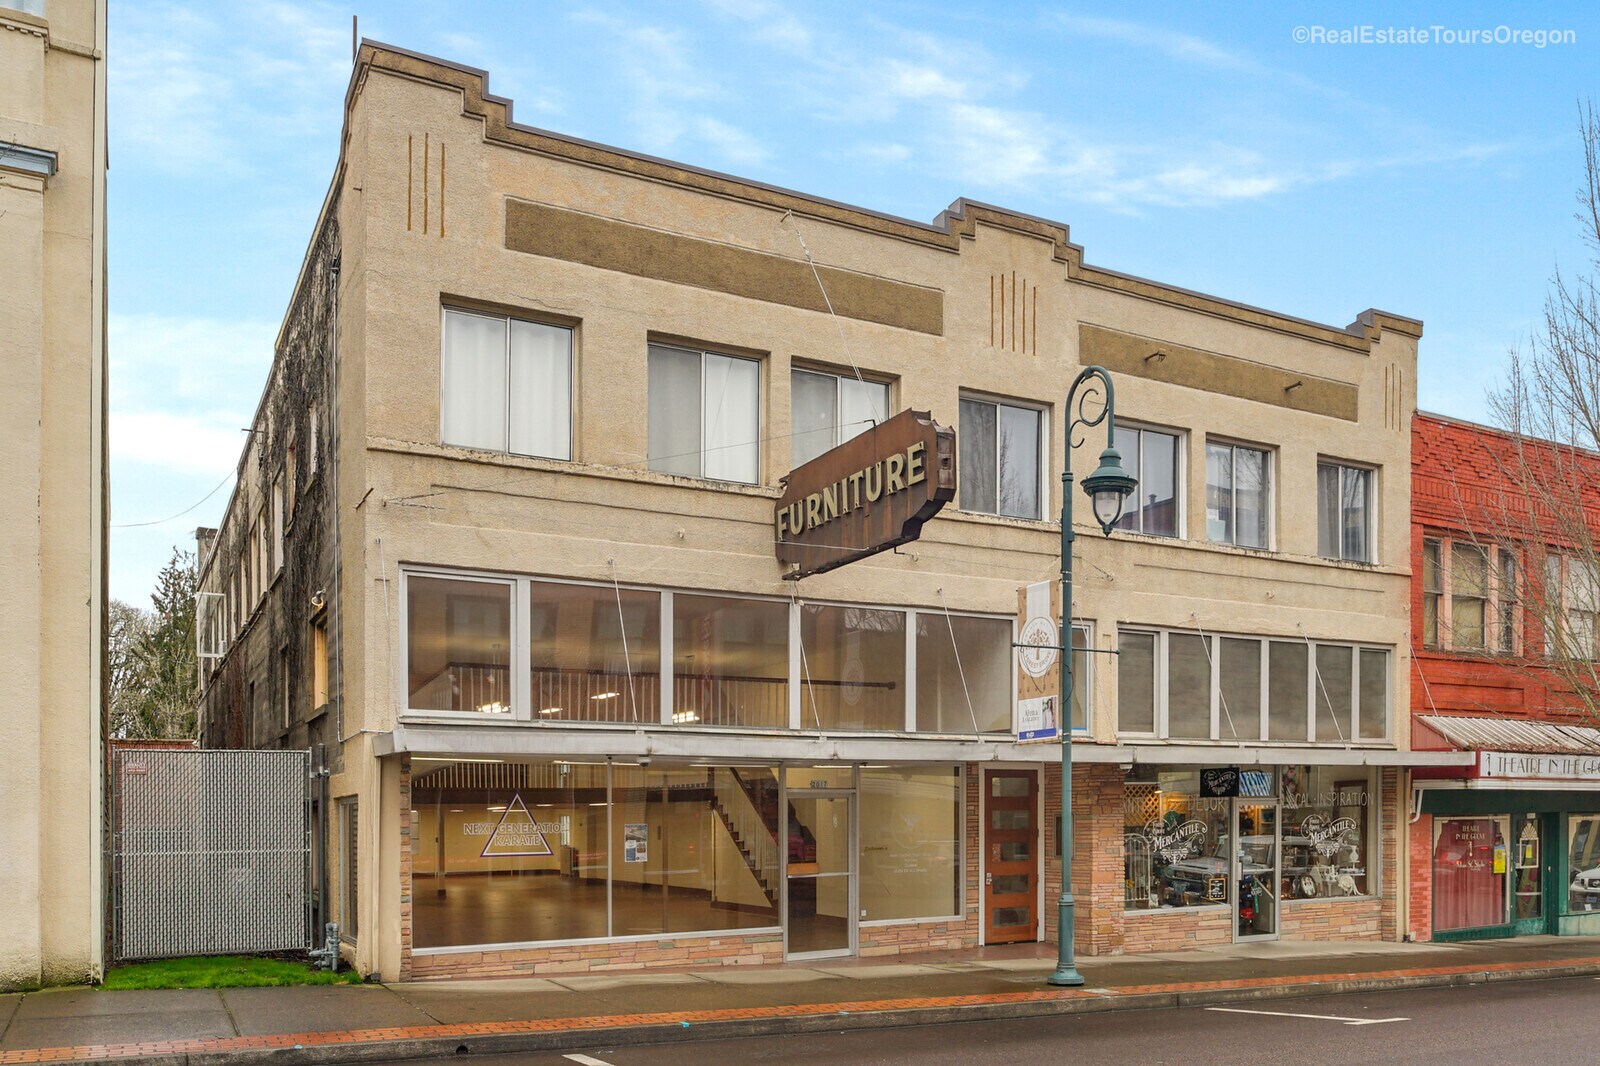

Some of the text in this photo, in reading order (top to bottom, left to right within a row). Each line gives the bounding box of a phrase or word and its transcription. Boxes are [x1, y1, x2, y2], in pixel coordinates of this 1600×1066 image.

[777, 441, 926, 542] FURNITURE
[1497, 756, 1544, 774] THEATRE
[1548, 759, 1559, 774] IN
[1561, 759, 1581, 775] THE
[1317, 791, 1374, 807] INSPIRATION
[463, 822, 495, 835] NEXT
[1153, 822, 1200, 852] MERCANTILE
[1309, 820, 1350, 847] MERCANTILE
[494, 834, 541, 846] KARATE
